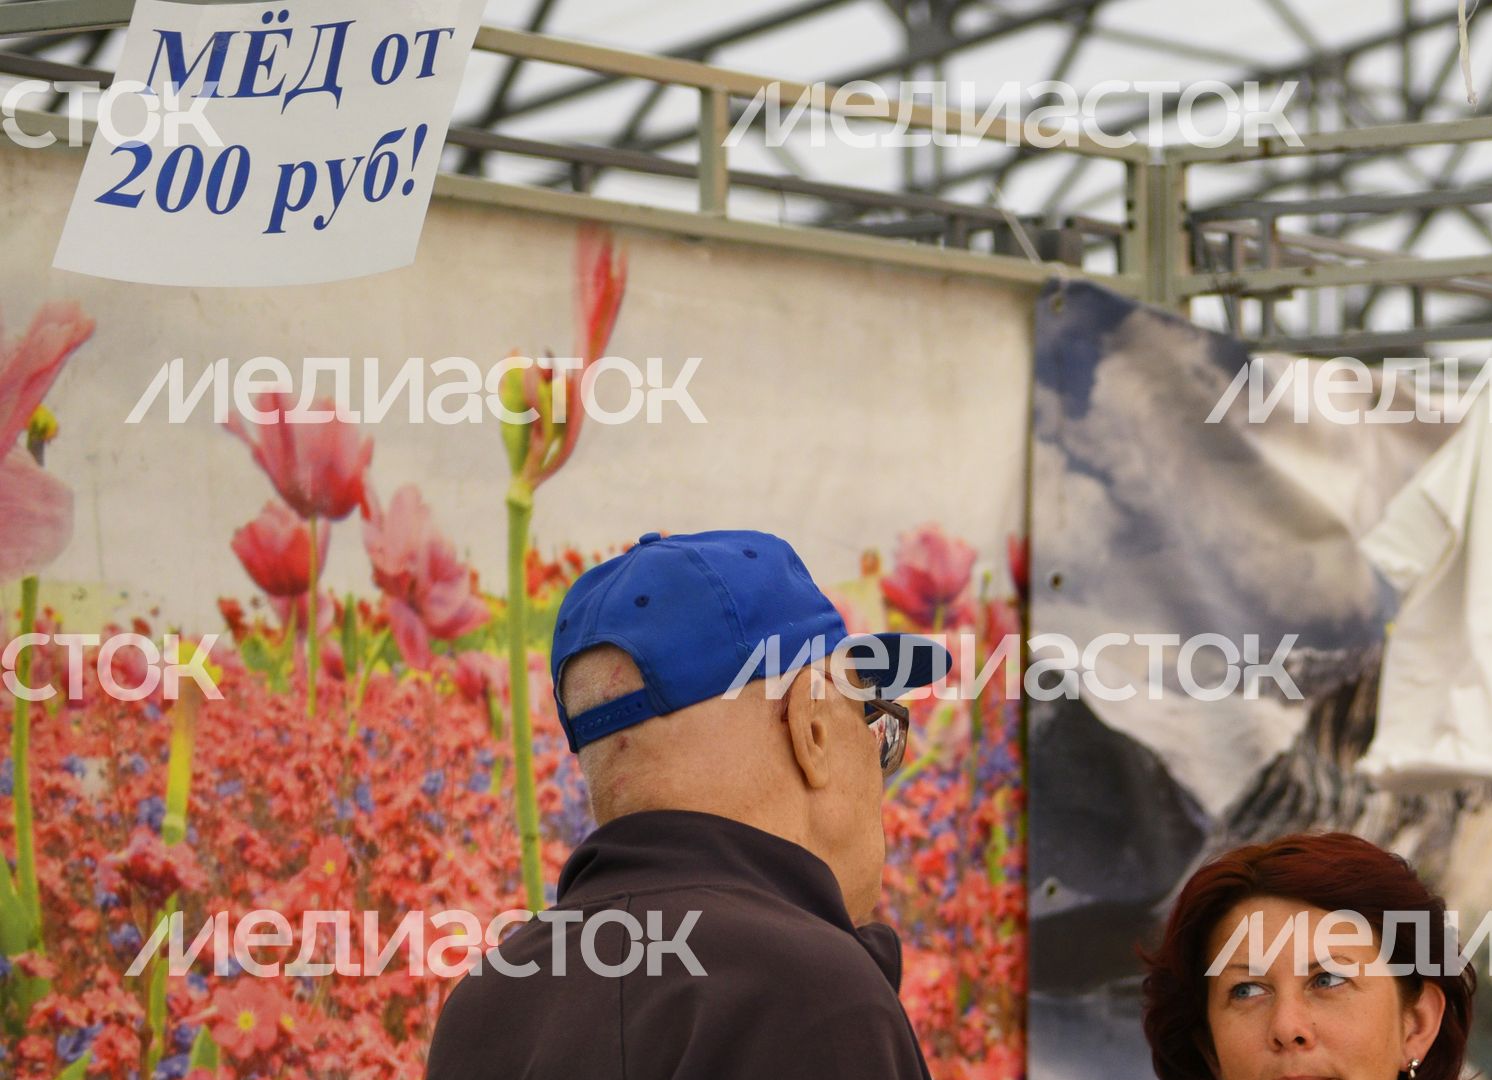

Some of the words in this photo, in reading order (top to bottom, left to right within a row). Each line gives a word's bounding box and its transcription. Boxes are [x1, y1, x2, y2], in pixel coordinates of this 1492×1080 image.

[134, 9, 356, 115] МЁД
[370, 27, 455, 87] от
[94, 141, 251, 215] 200
[262, 123, 430, 235] руб!
